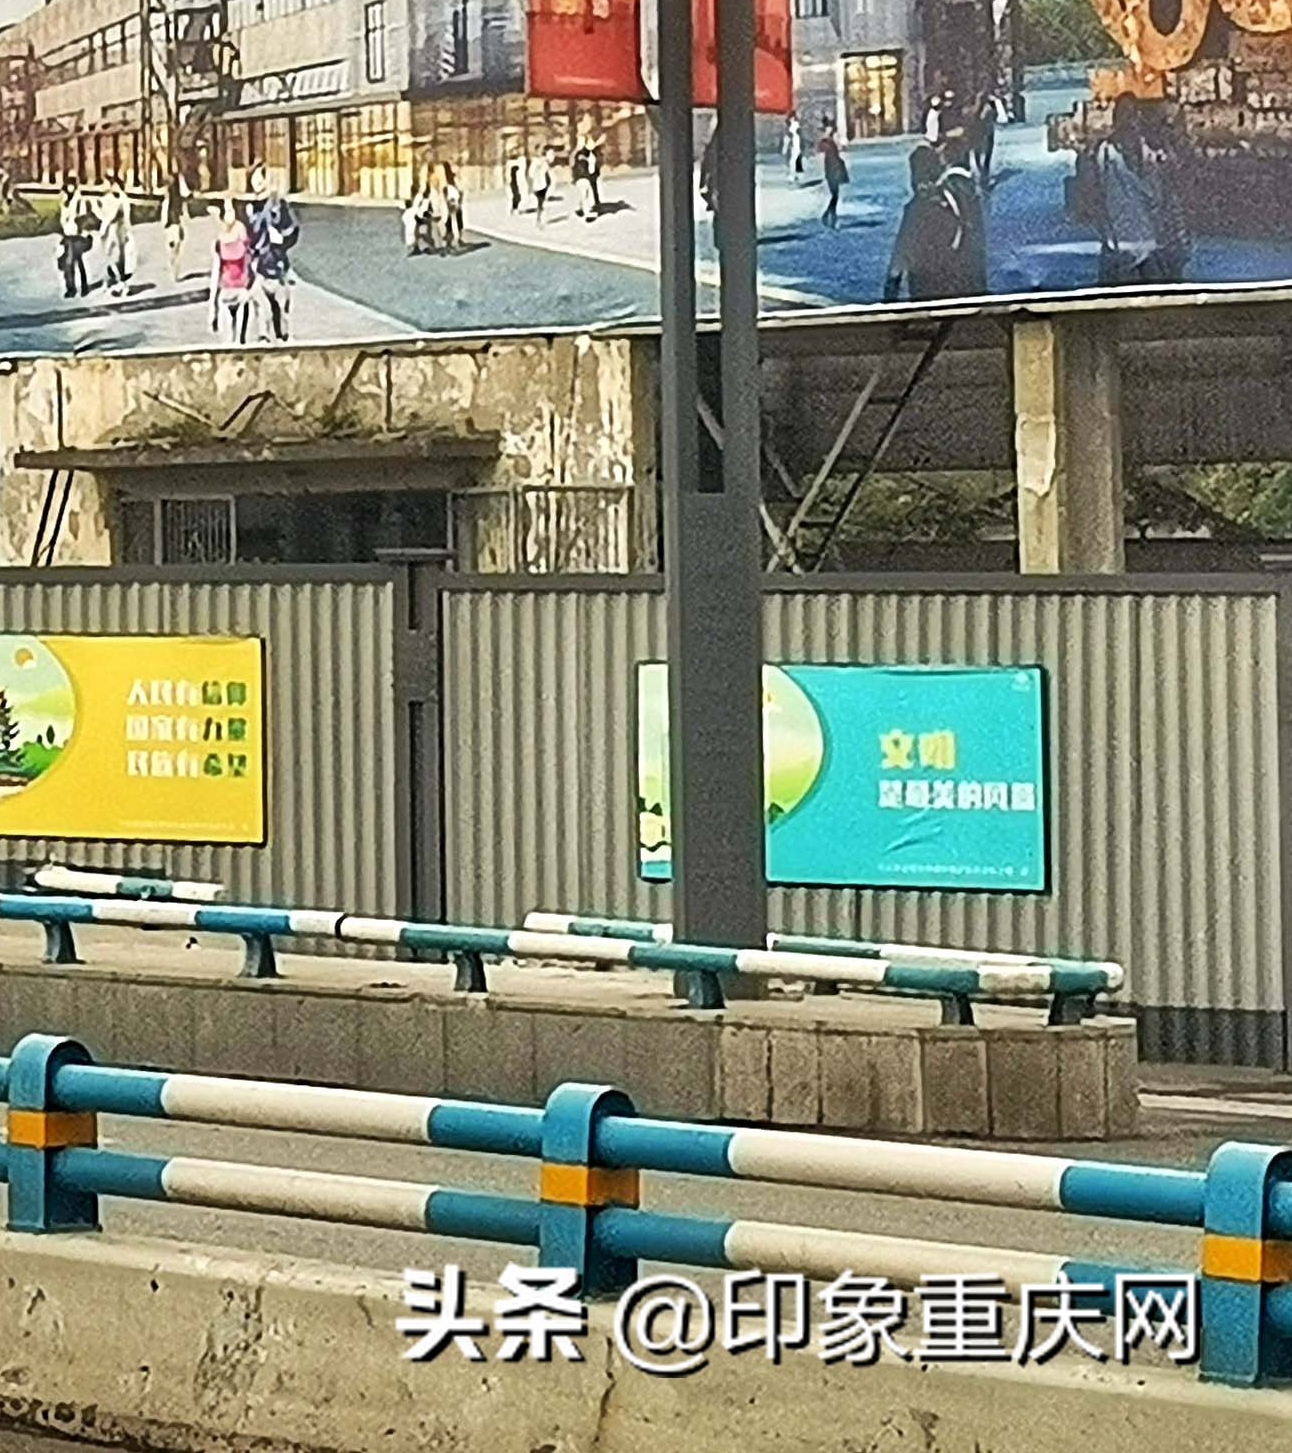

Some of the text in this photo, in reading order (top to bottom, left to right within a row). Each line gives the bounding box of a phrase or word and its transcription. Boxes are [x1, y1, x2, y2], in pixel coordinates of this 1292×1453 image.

[126, 678, 247, 707] 人民有信仰
[126, 714, 247, 742] 国家有力量
[126, 749, 247, 779] 民族有希望
[878, 728, 957, 771] 文明
